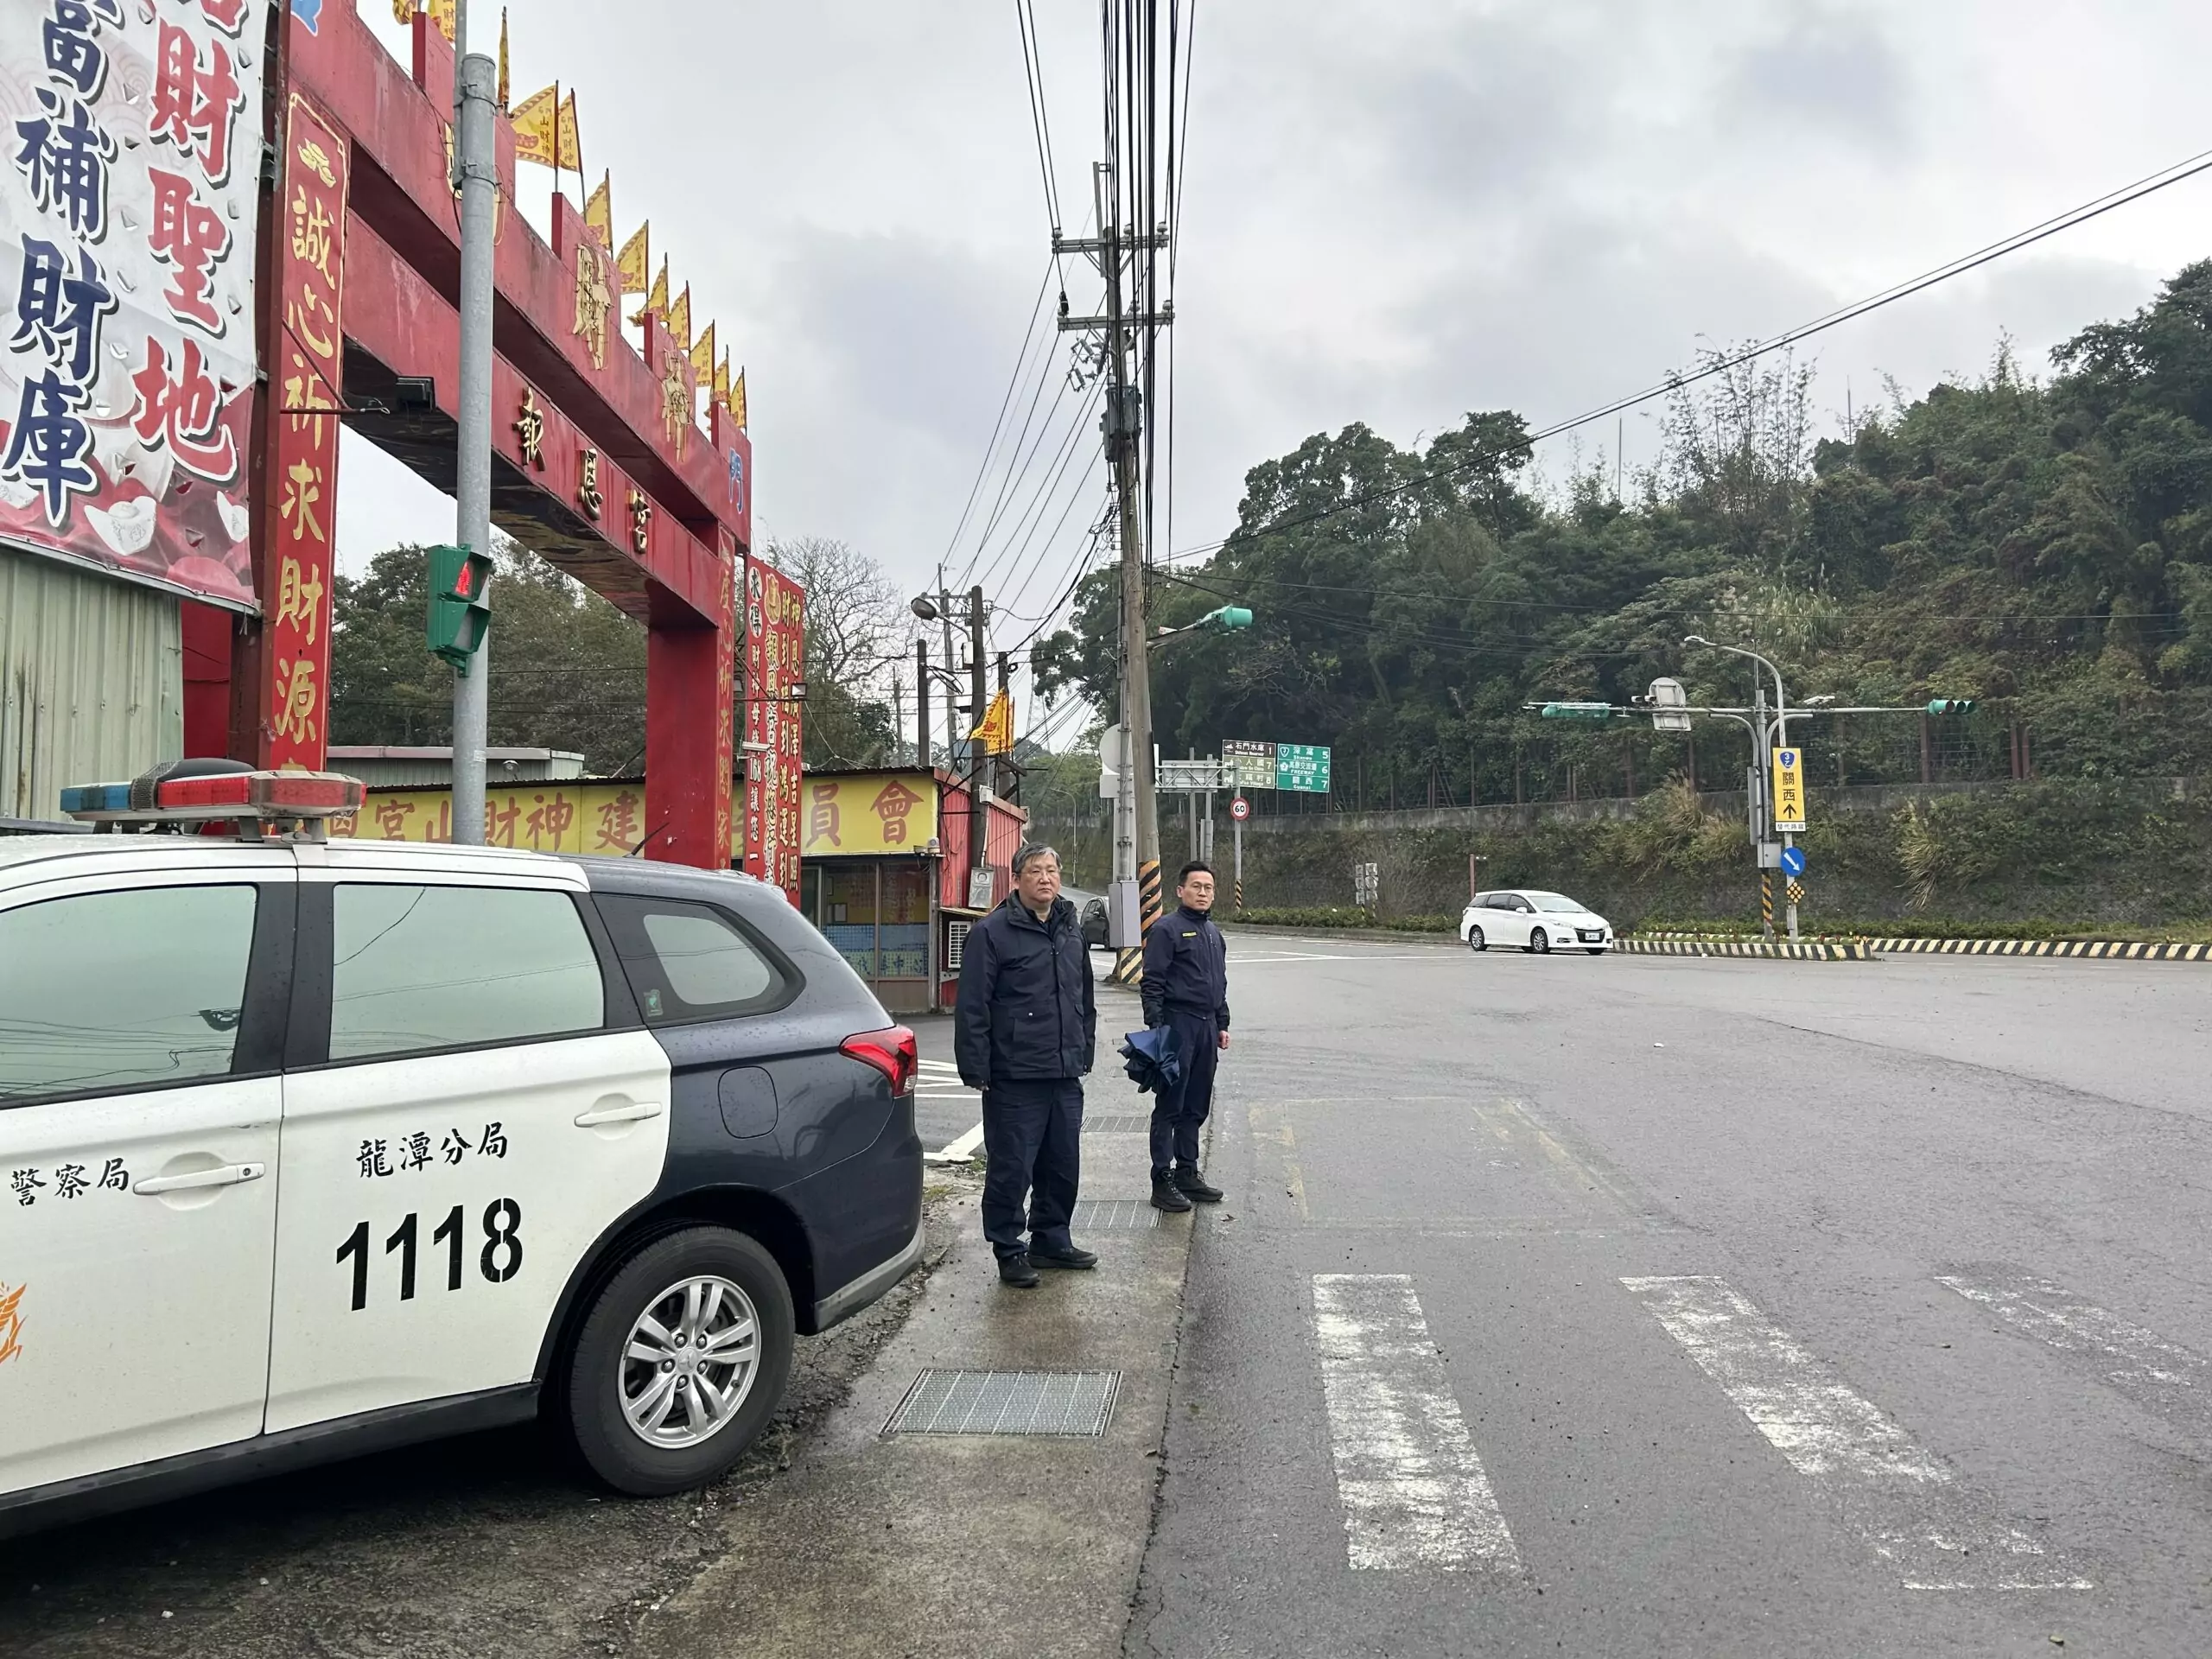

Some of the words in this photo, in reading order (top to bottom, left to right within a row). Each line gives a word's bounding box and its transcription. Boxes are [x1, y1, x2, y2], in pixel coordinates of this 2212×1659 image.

[132, 0, 245, 484] 財聖地
[273, 197, 339, 771] 誠心祈求財源
[1235, 742, 1265, 752] 石門水庫
[1268, 747, 1272, 755] 1
[1322, 751, 1329, 760] 5
[748, 645, 762, 880] 財神母錢168讓您一
[1266, 761, 1272, 770] 7
[1321, 766, 1328, 774] 6
[1266, 776, 1272, 785] 8
[1321, 780, 1328, 789] 7
[1783, 772, 1796, 802] 關西
[1235, 804, 1245, 813] 60
[355, 1122, 508, 1179] 龍潭分局
[10, 1157, 130, 1207] 警察局
[336, 1197, 524, 1312] 1118
